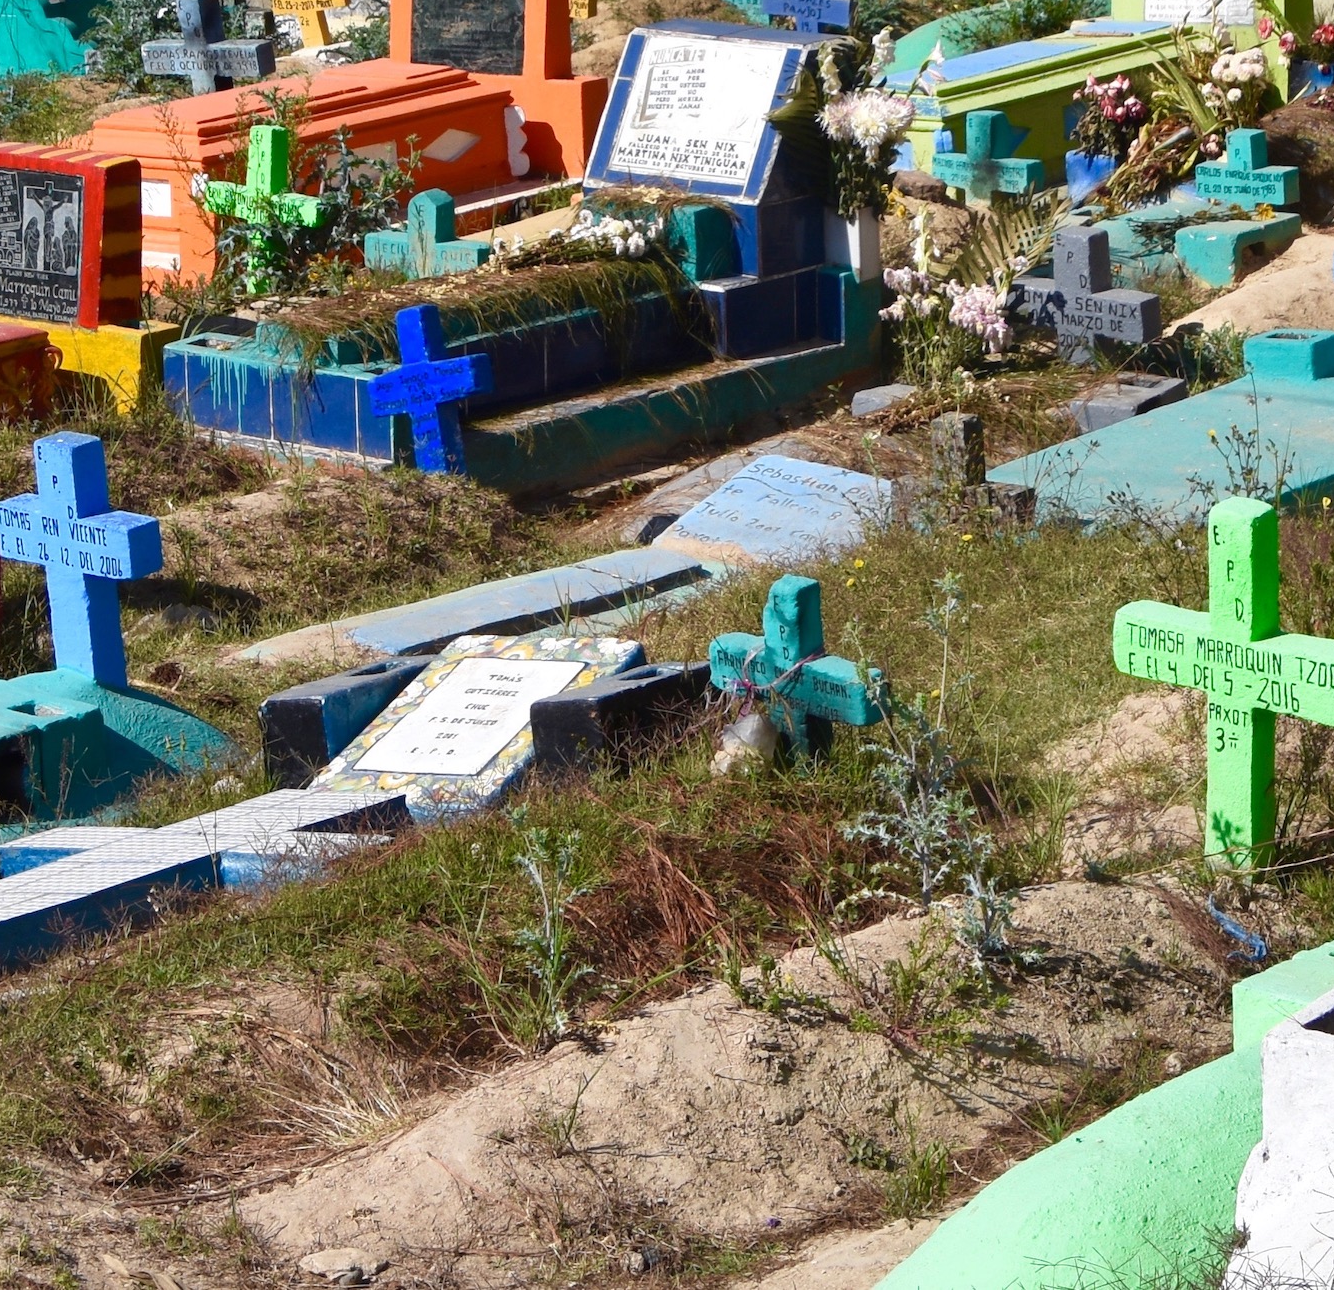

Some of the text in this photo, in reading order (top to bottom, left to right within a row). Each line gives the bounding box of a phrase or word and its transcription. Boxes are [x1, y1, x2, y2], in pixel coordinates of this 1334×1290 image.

[184, 49, 218, 59] RAMOS
[686, 139, 708, 148] SEN
[715, 141, 737, 152] NIX
[618, 147, 746, 170] MARTINA NIX TINIGUAR
[1196, 166, 1221, 177] CARLOS
[39, 298, 61, 313] Mayo
[62, 302, 77, 315] 2009
[1076, 297, 1103, 313] SEN
[1109, 303, 1137, 319] NIX
[1061, 314, 1103, 330] MARZO
[1111, 320, 1123, 332] DE
[748, 463, 838, 493] Sebastian
[42, 517, 59, 537] REN
[68, 522, 107, 546] VICENTE
[79, 551, 94, 571] DEL
[1126, 623, 1184, 654] TOMASA
[1197, 637, 1282, 676] MARROQUIN
[1147, 655, 1158, 678] EL
[1194, 664, 1216, 691] DEL
[1257, 678, 1300, 713] 2016
